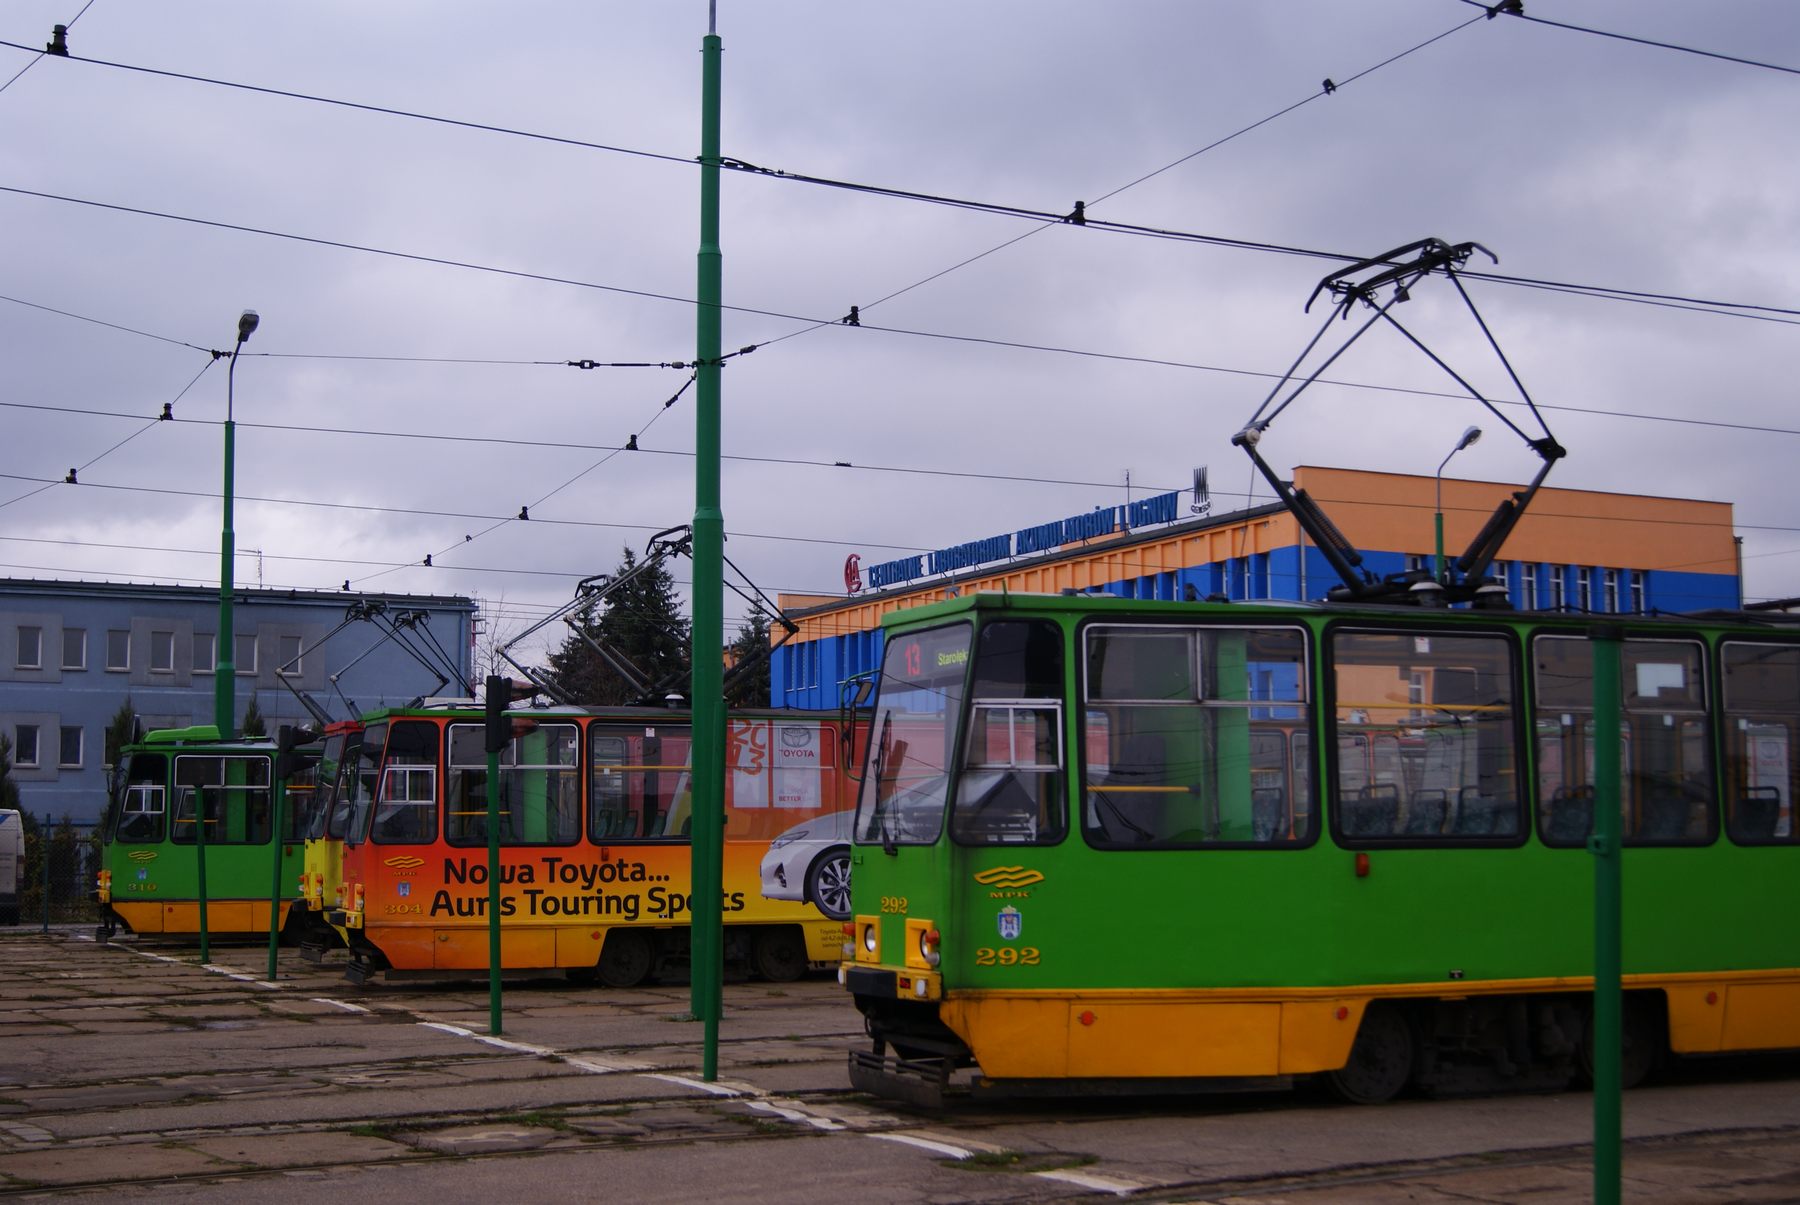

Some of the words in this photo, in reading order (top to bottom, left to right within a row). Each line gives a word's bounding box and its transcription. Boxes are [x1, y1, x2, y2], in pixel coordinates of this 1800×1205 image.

[904, 643, 921, 676] 13
[778, 749, 815, 758] TOYOTA
[384, 903, 424, 915] 304
[430, 889, 517, 917] Aurs
[523, 887, 641, 921] Touring
[647, 887, 745, 919] Spts
[881, 896, 908, 914] 292
[976, 947, 1041, 967] 292
